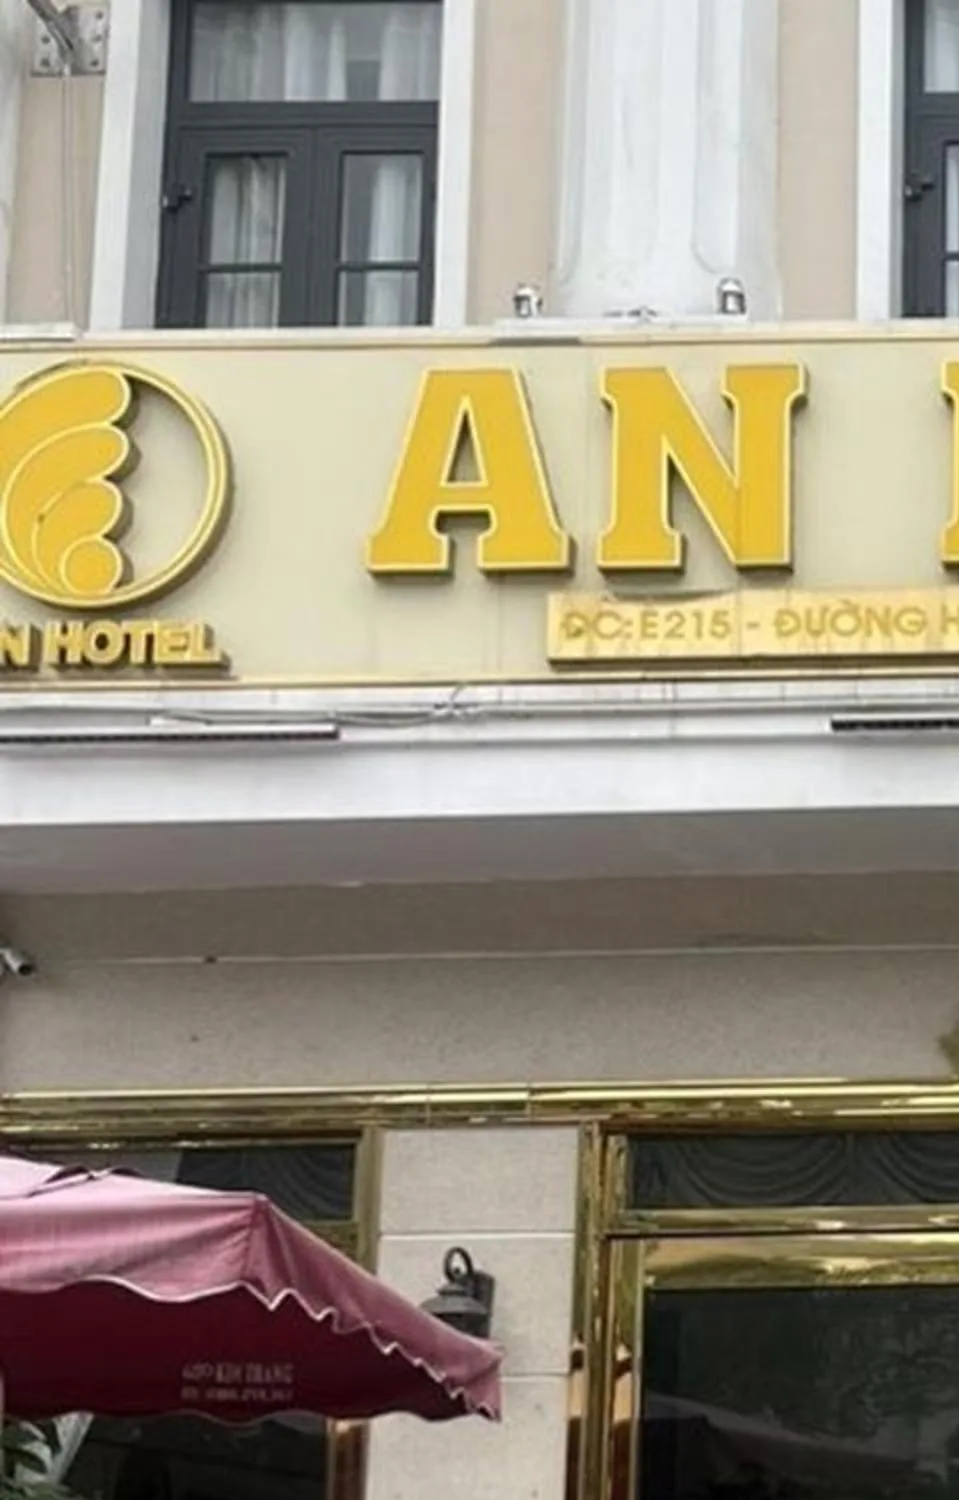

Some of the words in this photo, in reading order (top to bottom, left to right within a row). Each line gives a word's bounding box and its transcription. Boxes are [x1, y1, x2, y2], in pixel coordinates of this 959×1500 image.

[365, 362, 806, 574] AN
[773, 598, 928, 639] ĐƯỜNG
[43, 619, 221, 667] HOTEL
